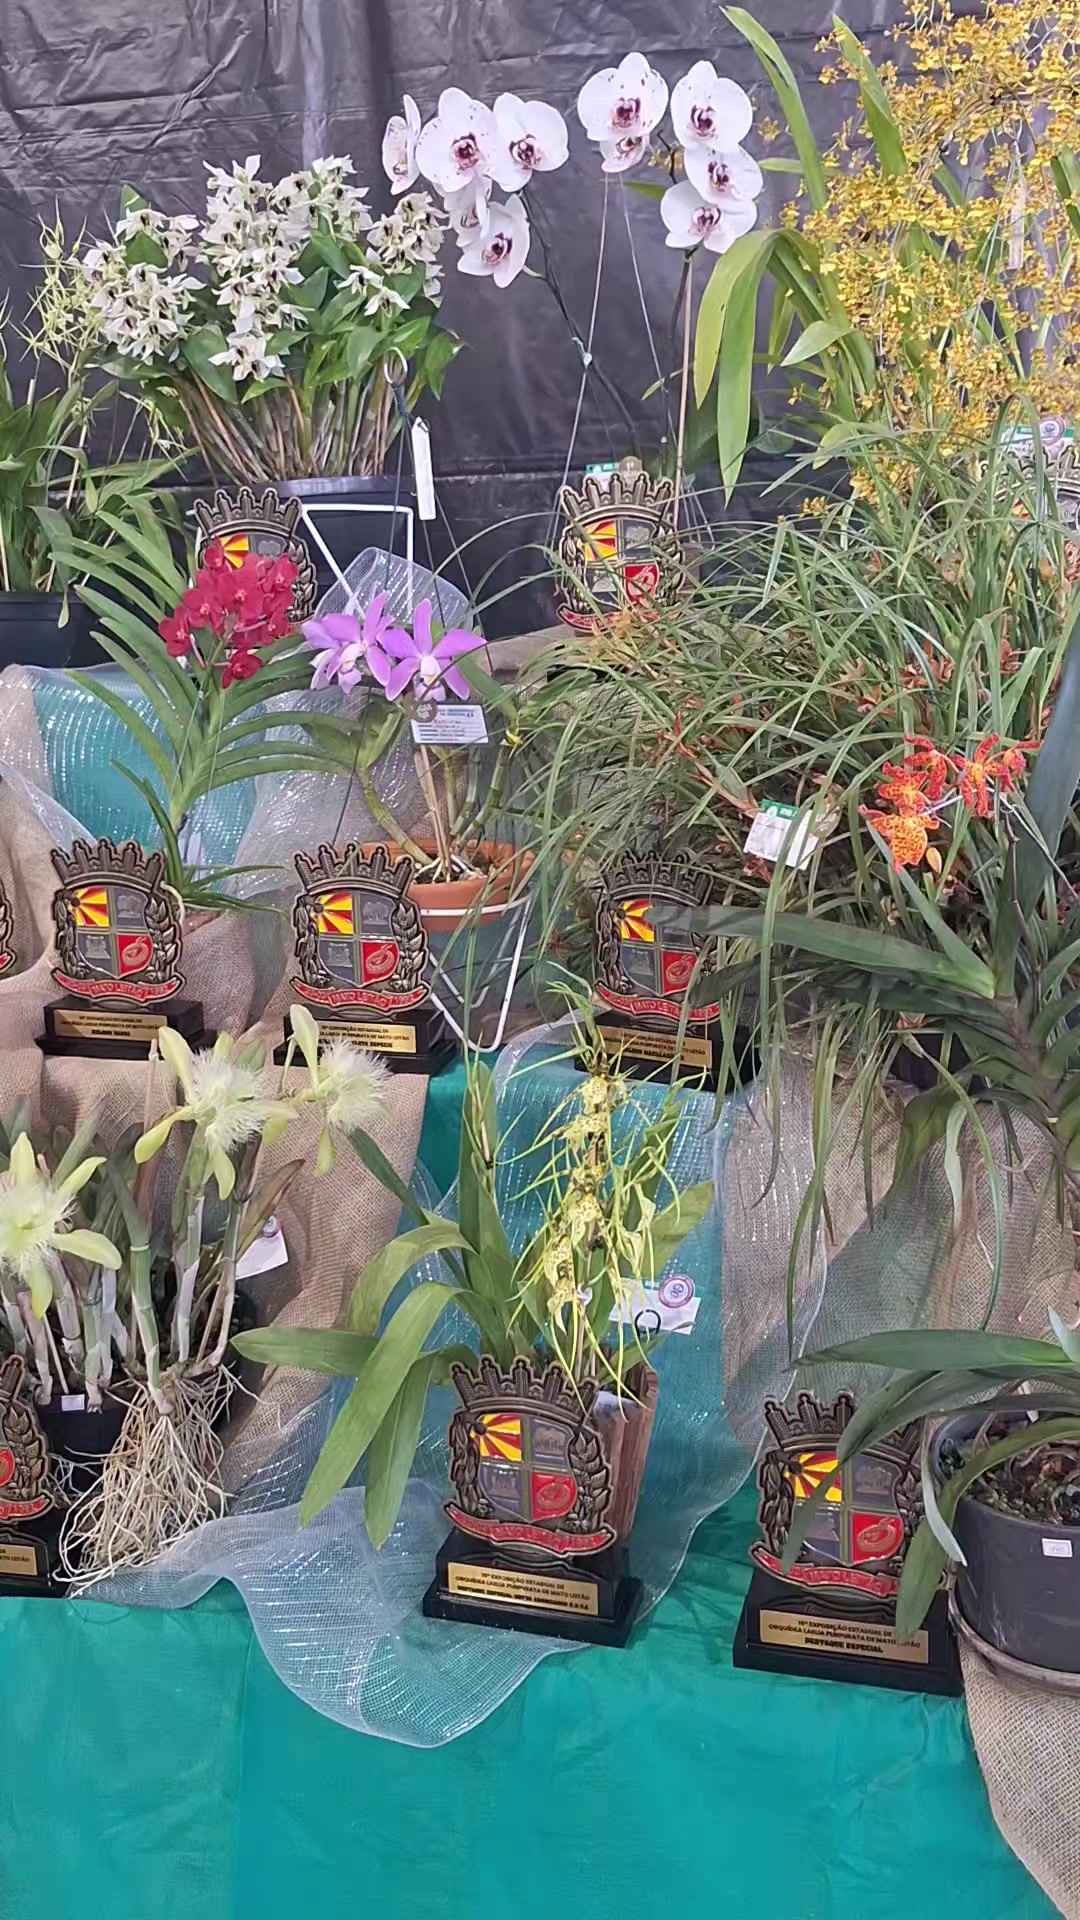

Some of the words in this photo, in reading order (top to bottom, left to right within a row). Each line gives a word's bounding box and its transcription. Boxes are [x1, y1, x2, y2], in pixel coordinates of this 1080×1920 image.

[92, 983, 114, 994] MATO
[331, 992, 356, 1001] MATO
[634, 1002, 657, 1010] MATO
[768, 1623, 803, 1633] ORQUÍDEA
[826, 1631, 866, 1642] PURPURATA
[876, 1637, 897, 1645] MATO
[809, 1621, 847, 1632] EXPOSIÇÃO
[847, 1626, 883, 1636] ESTADUAL
[804, 1637, 845, 1649] DESTAQUE
[845, 1641, 884, 1654] ESPECIAL
